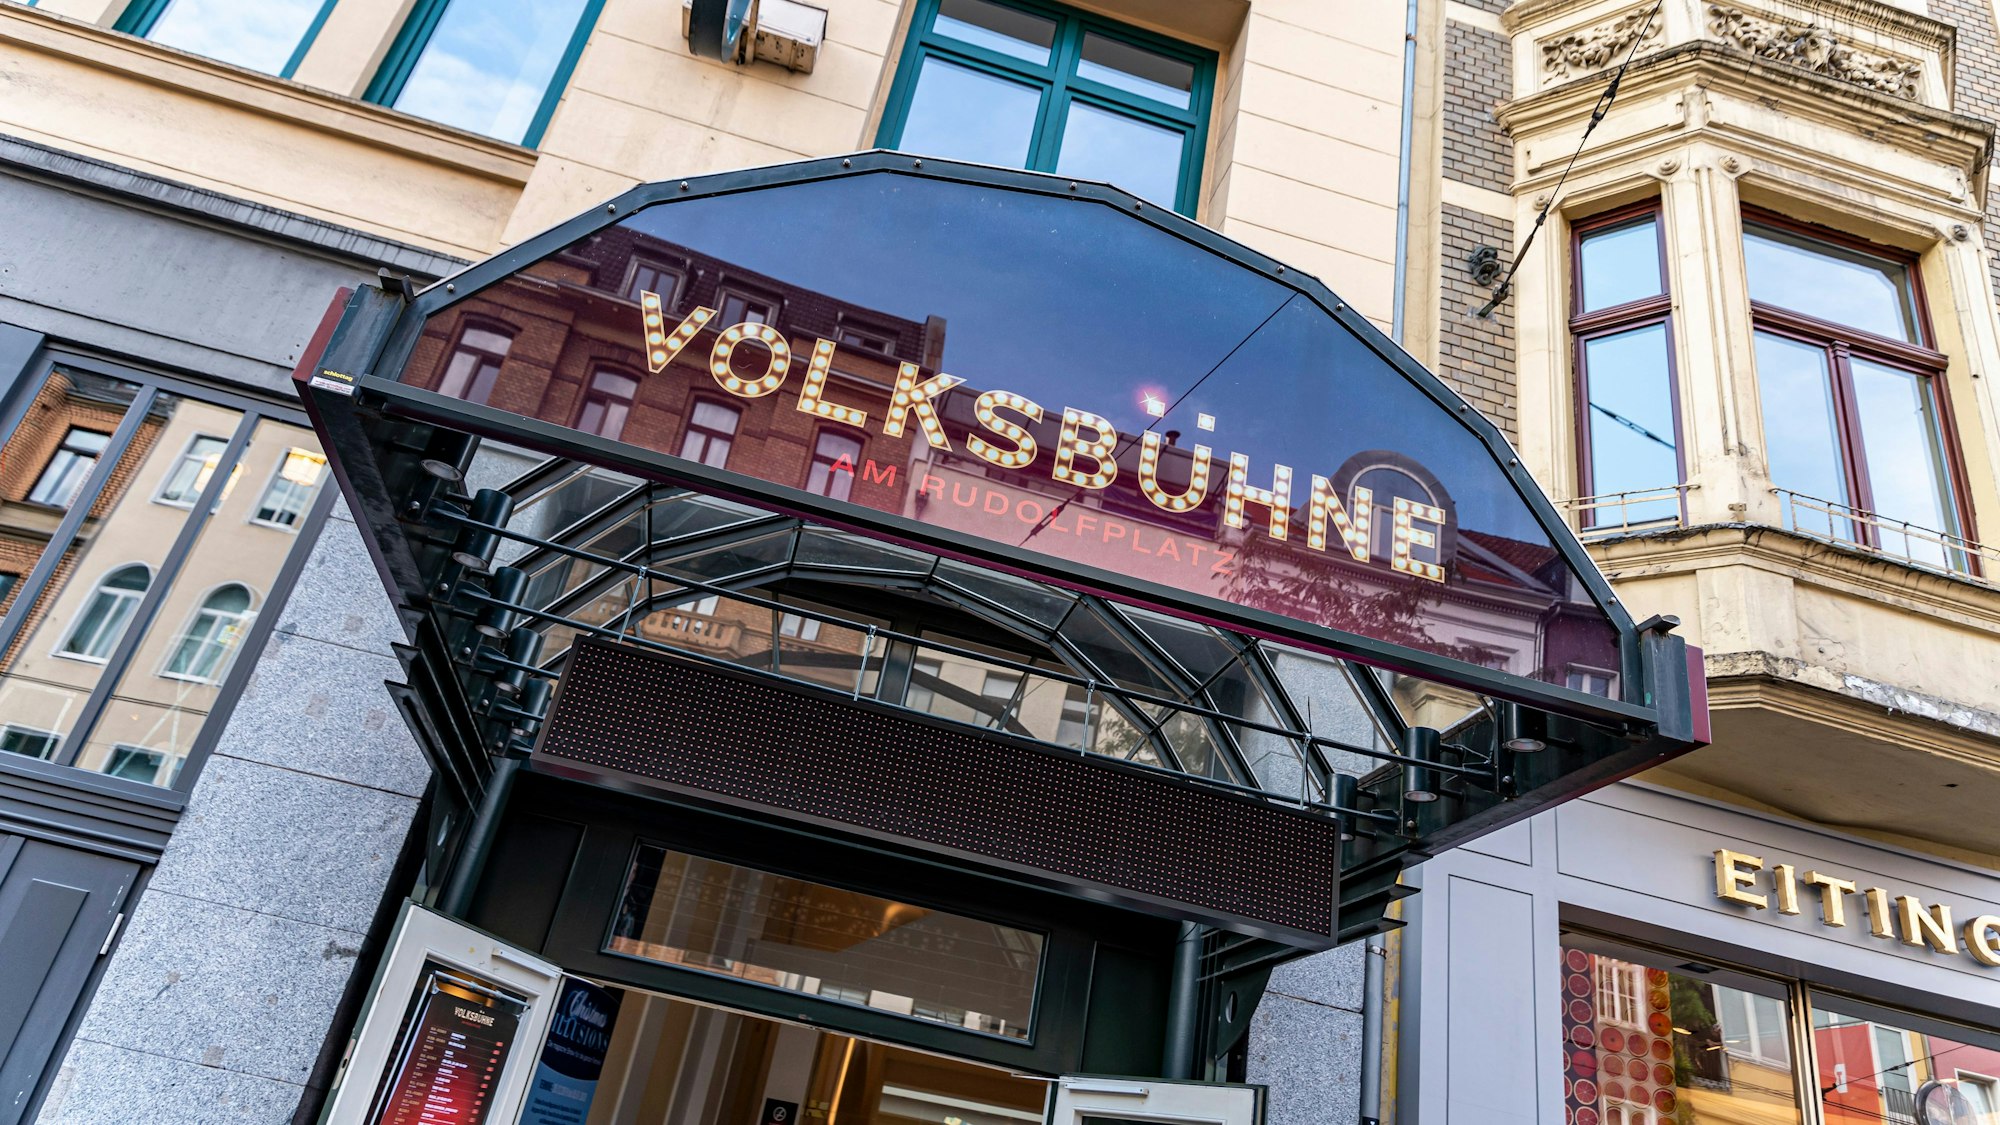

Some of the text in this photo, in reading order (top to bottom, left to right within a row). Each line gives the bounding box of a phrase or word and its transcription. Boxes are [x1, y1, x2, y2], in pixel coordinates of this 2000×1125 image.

[640, 290, 1446, 583] VOLKSBÜHNE
[829, 453, 1237, 576] AM RUDOLFPLATZ
[1713, 848, 2000, 967] EITING
[454, 1006, 495, 1027] VOLKSBÜHNE
